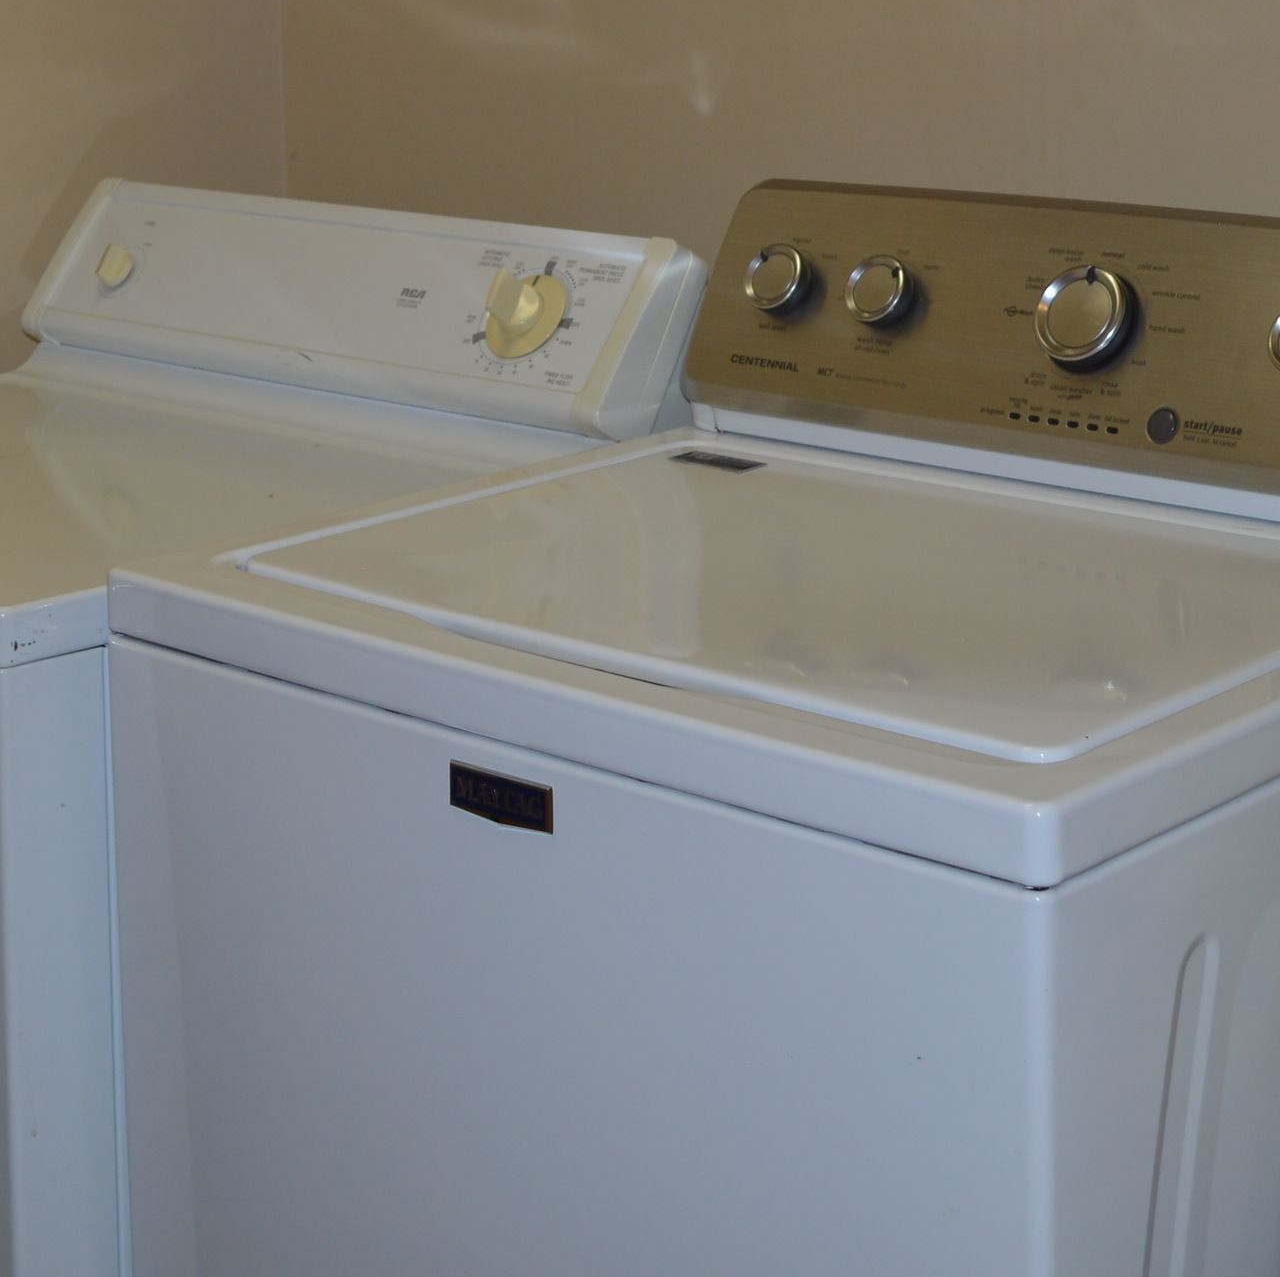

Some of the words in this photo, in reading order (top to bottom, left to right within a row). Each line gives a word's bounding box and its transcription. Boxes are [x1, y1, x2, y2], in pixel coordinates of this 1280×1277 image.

[400, 287, 426, 299] RCA
[730, 354, 799, 373] CENTENNIAL
[1184, 419, 1243, 436] start/pause
